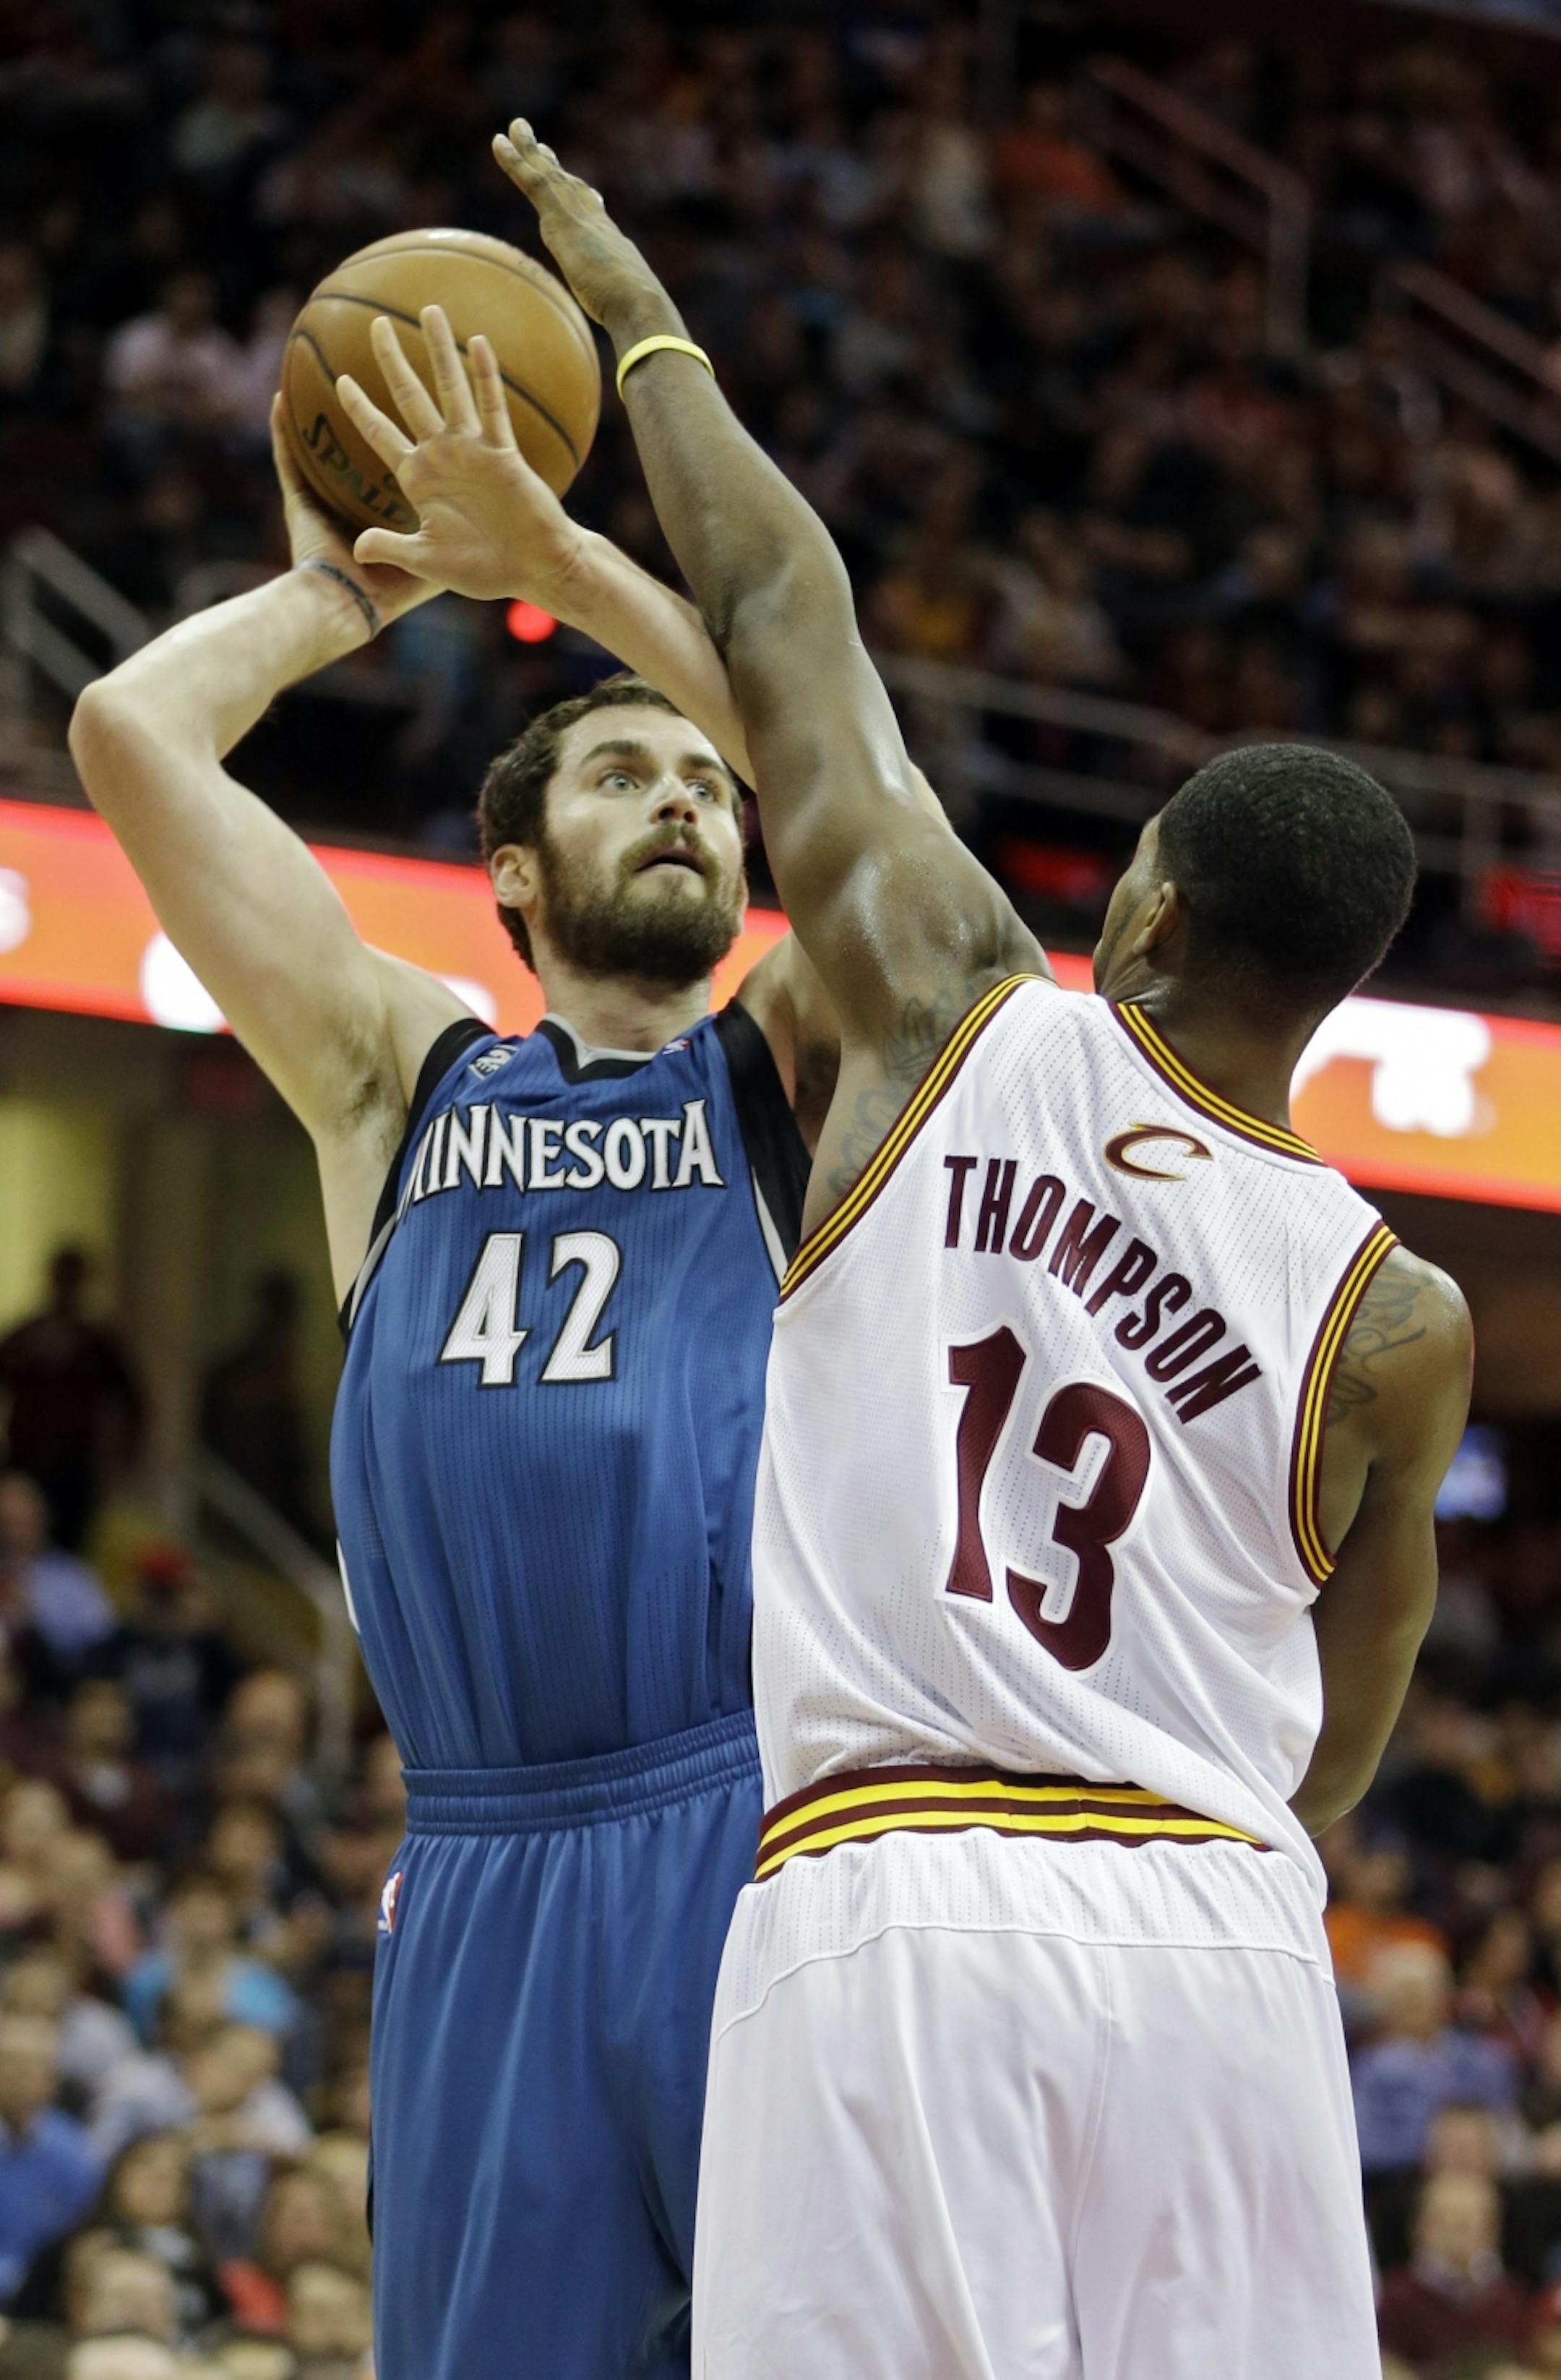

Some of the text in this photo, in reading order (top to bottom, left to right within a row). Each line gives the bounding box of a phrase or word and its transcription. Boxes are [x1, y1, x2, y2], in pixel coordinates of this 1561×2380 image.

[435, 1231, 622, 1388] 42
[943, 1155, 1263, 1425] THOMPSON
[944, 1324, 1152, 1672] 13
